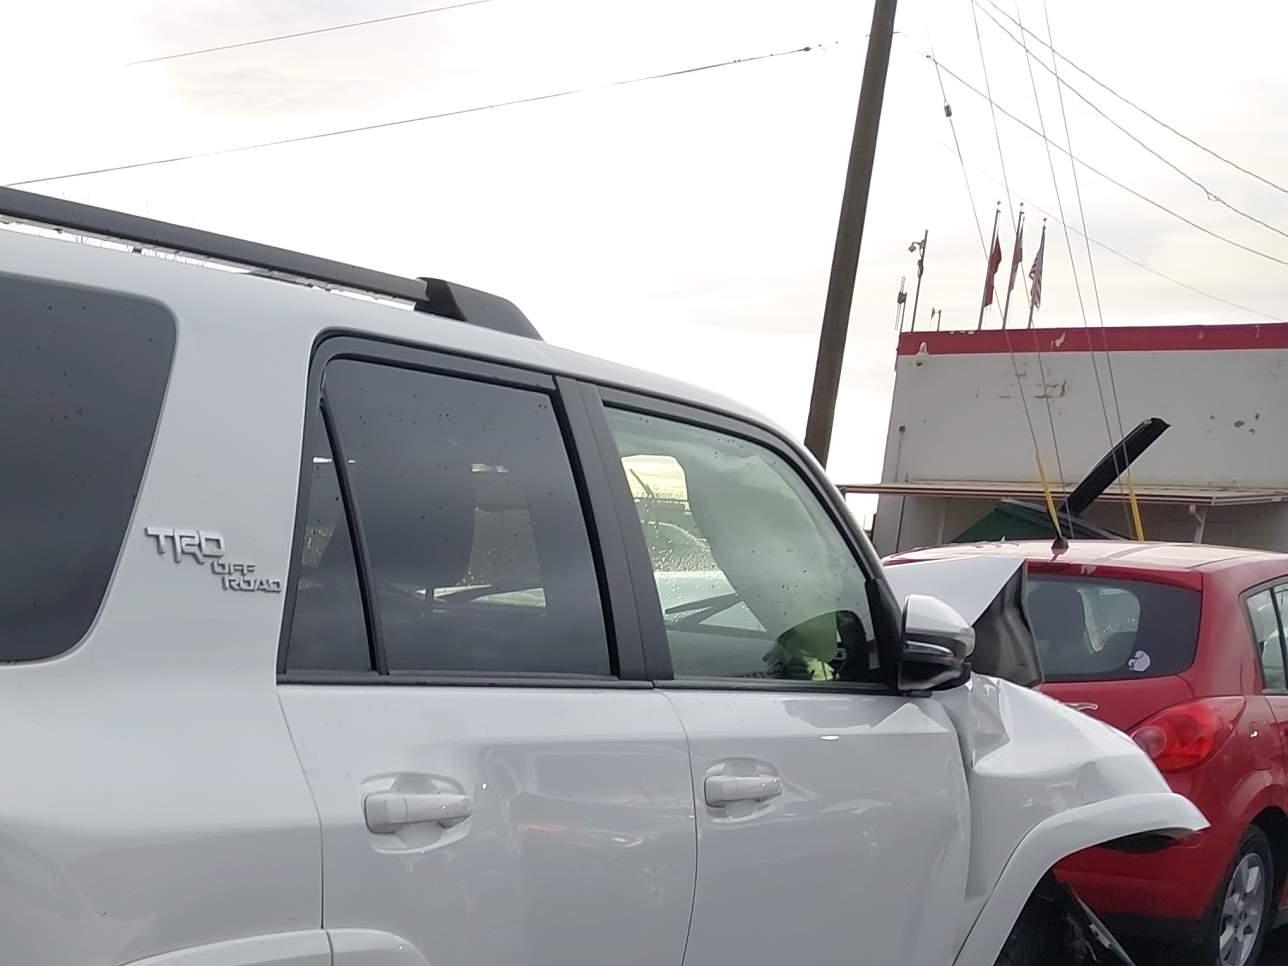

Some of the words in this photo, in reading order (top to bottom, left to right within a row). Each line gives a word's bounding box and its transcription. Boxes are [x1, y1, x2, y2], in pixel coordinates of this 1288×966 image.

[144, 526, 224, 564] TRD
[212, 559, 255, 576] OFF
[221, 576, 281, 593] ROAD
